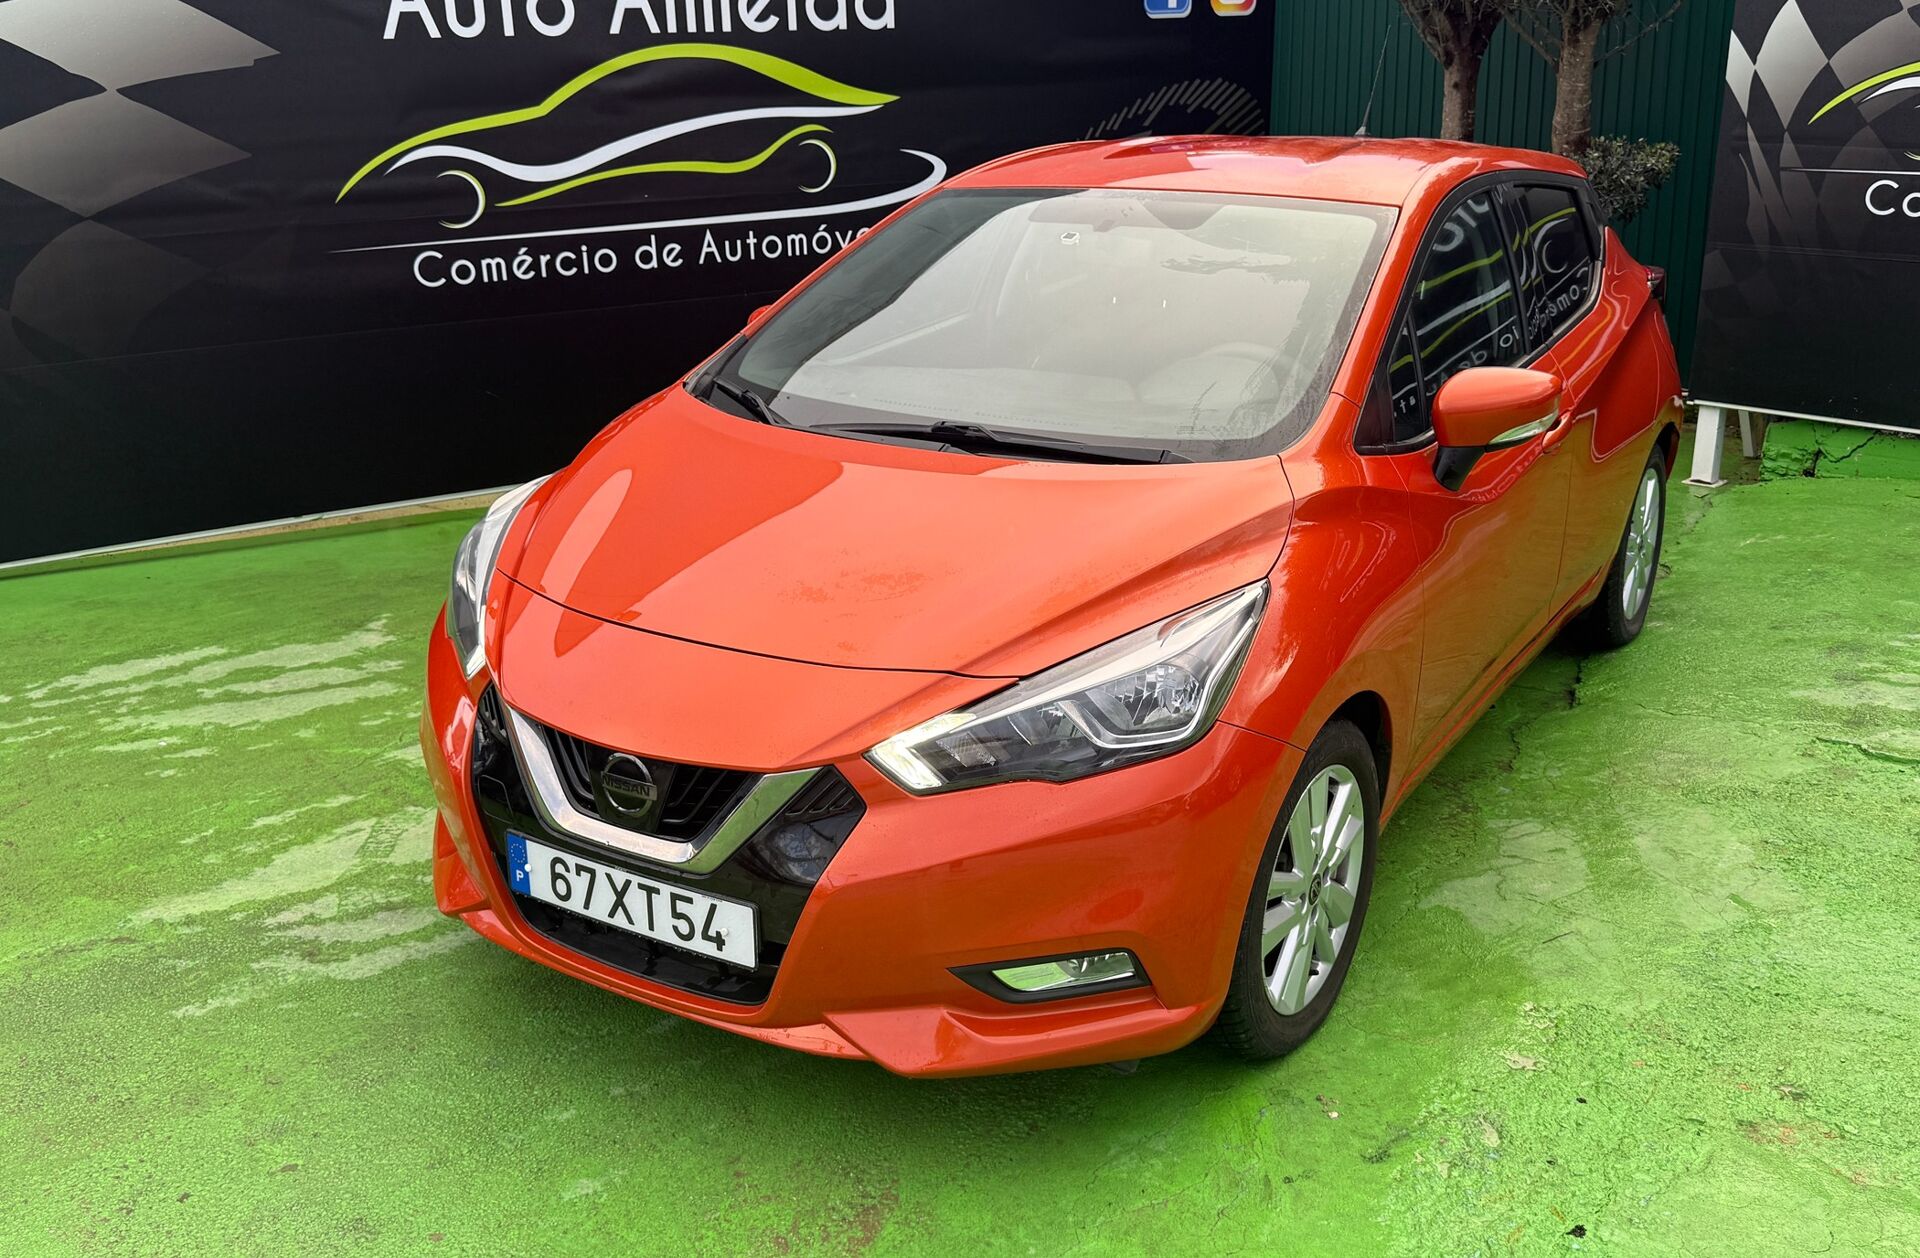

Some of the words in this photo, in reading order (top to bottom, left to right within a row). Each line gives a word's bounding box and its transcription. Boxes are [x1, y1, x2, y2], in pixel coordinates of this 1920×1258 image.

[413, 245, 617, 288] Comércio
[634, 234, 684, 270] de
[602, 773, 650, 797] NISSAN
[515, 870, 525, 882] P
[550, 856, 726, 952] 67XT54
